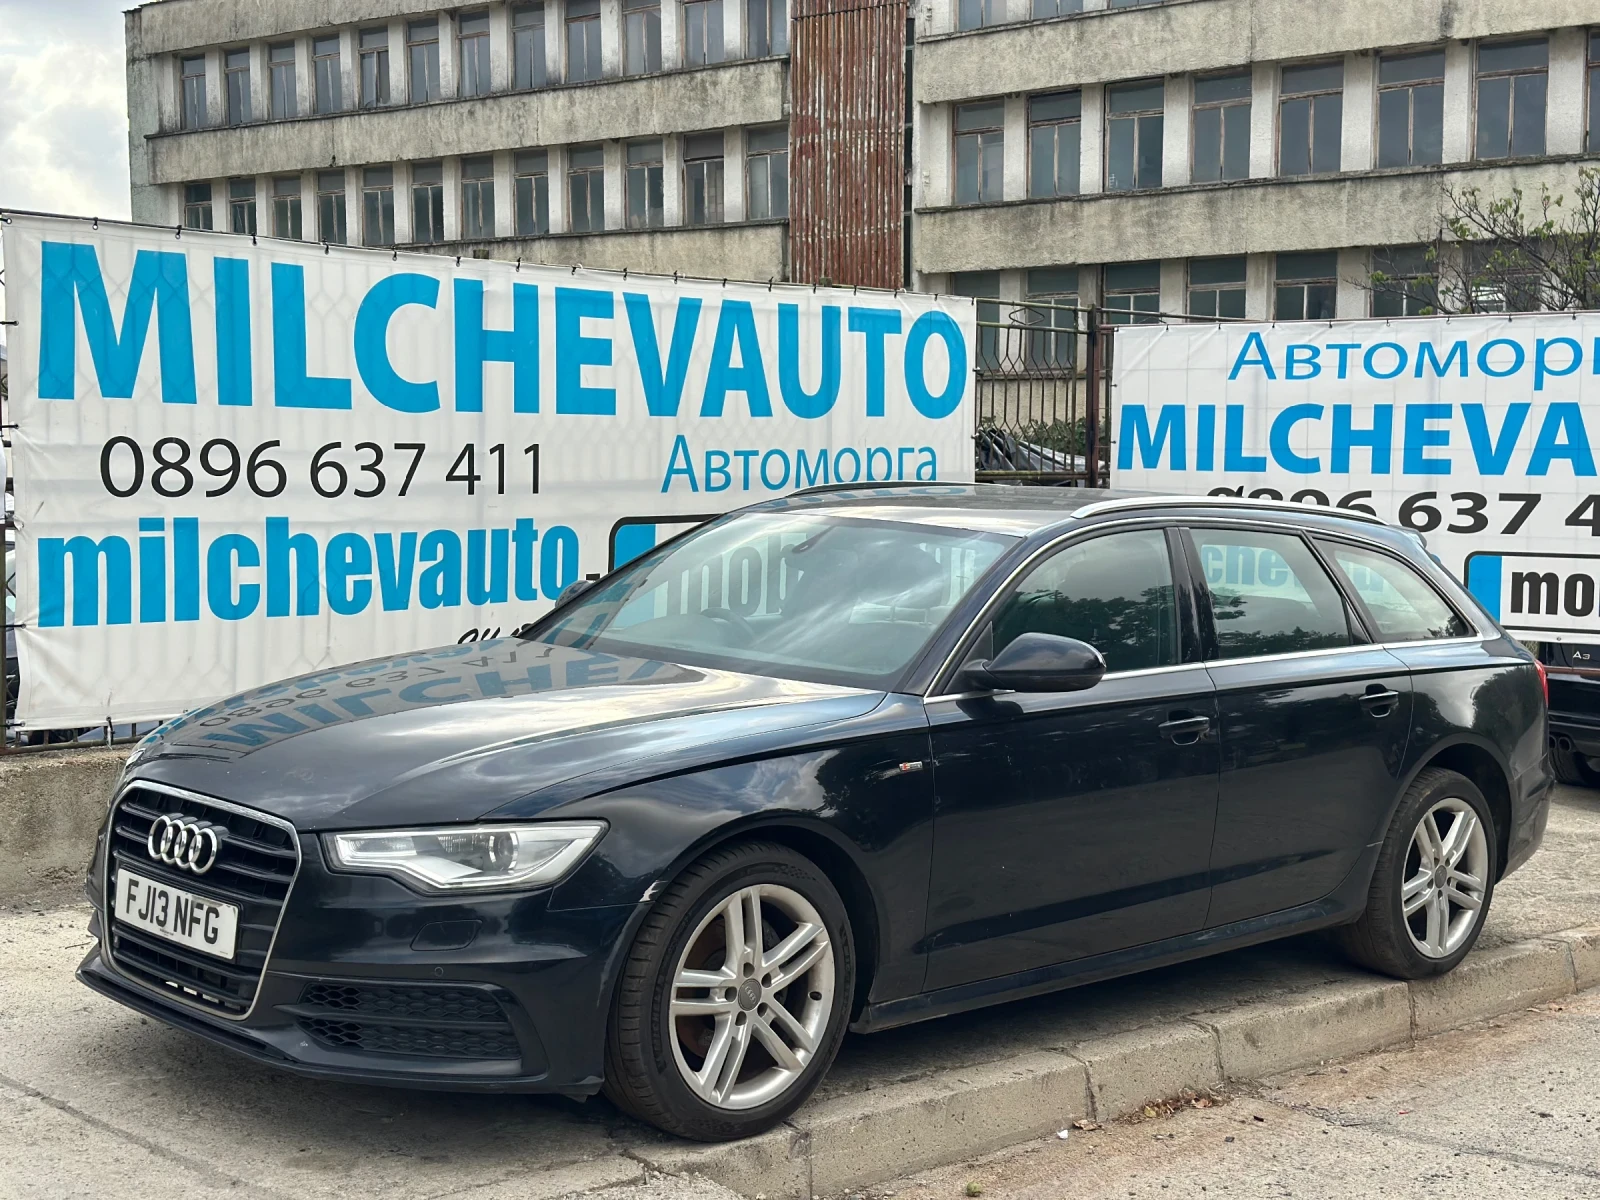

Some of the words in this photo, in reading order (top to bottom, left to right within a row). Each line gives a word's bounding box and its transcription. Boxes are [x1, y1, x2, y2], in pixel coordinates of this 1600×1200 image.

[38, 241, 967, 419] MILCHEVAUTO
[100, 436, 287, 498] 0896
[310, 442, 426, 498] 637
[446, 443, 541, 495] 411
[661, 434, 938, 494] Автоморга
[1117, 403, 1598, 477] MILCHEVA
[1398, 491, 1542, 535] 637
[1511, 571, 1600, 617] mo
[1572, 650, 1591, 660] A3
[126, 878, 169, 928] FJ13
[173, 895, 219, 945] NFG
